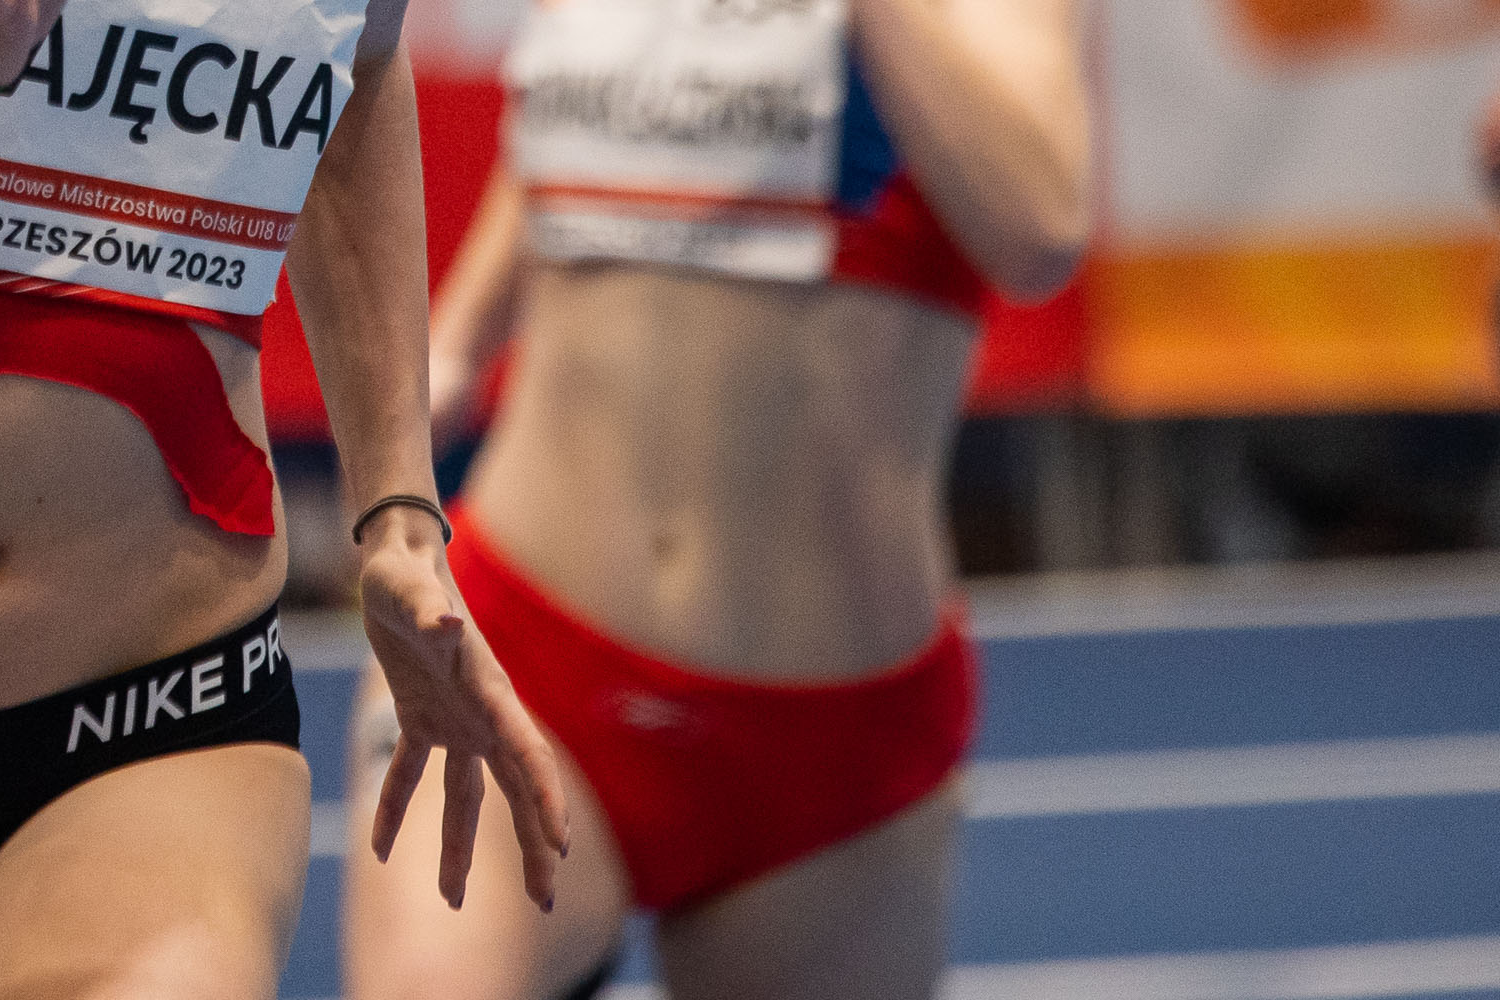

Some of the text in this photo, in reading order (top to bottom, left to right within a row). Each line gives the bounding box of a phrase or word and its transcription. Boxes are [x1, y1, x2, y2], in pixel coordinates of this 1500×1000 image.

[8, 14, 334, 155] AJĘCKA
[59, 183, 186, 224] Mistrzostwa
[190, 208, 244, 236] Polski
[247, 218, 275, 241] U18
[166, 248, 246, 290] 2023
[66, 617, 283, 754] NIKE PR
